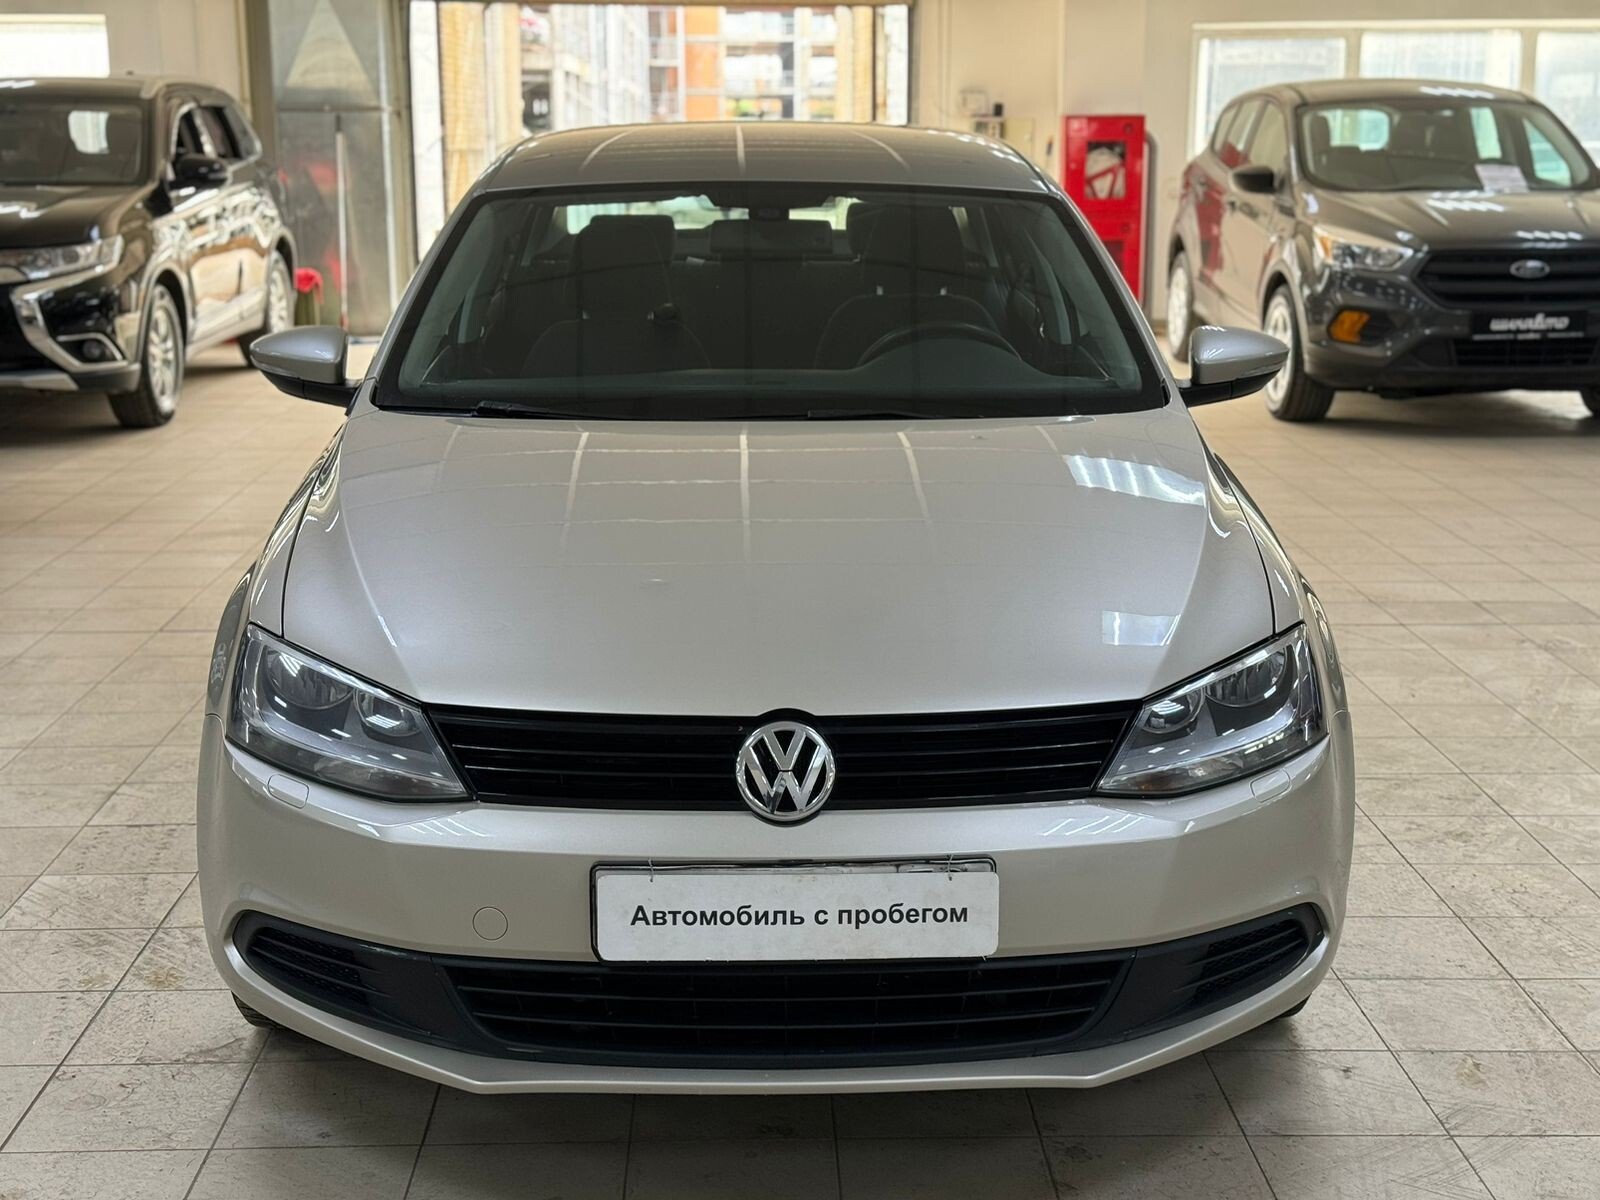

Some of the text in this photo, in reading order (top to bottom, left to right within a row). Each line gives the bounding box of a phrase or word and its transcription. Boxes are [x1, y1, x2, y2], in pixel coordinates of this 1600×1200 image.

[631, 902, 968, 930] Автомобиль с пробегом
